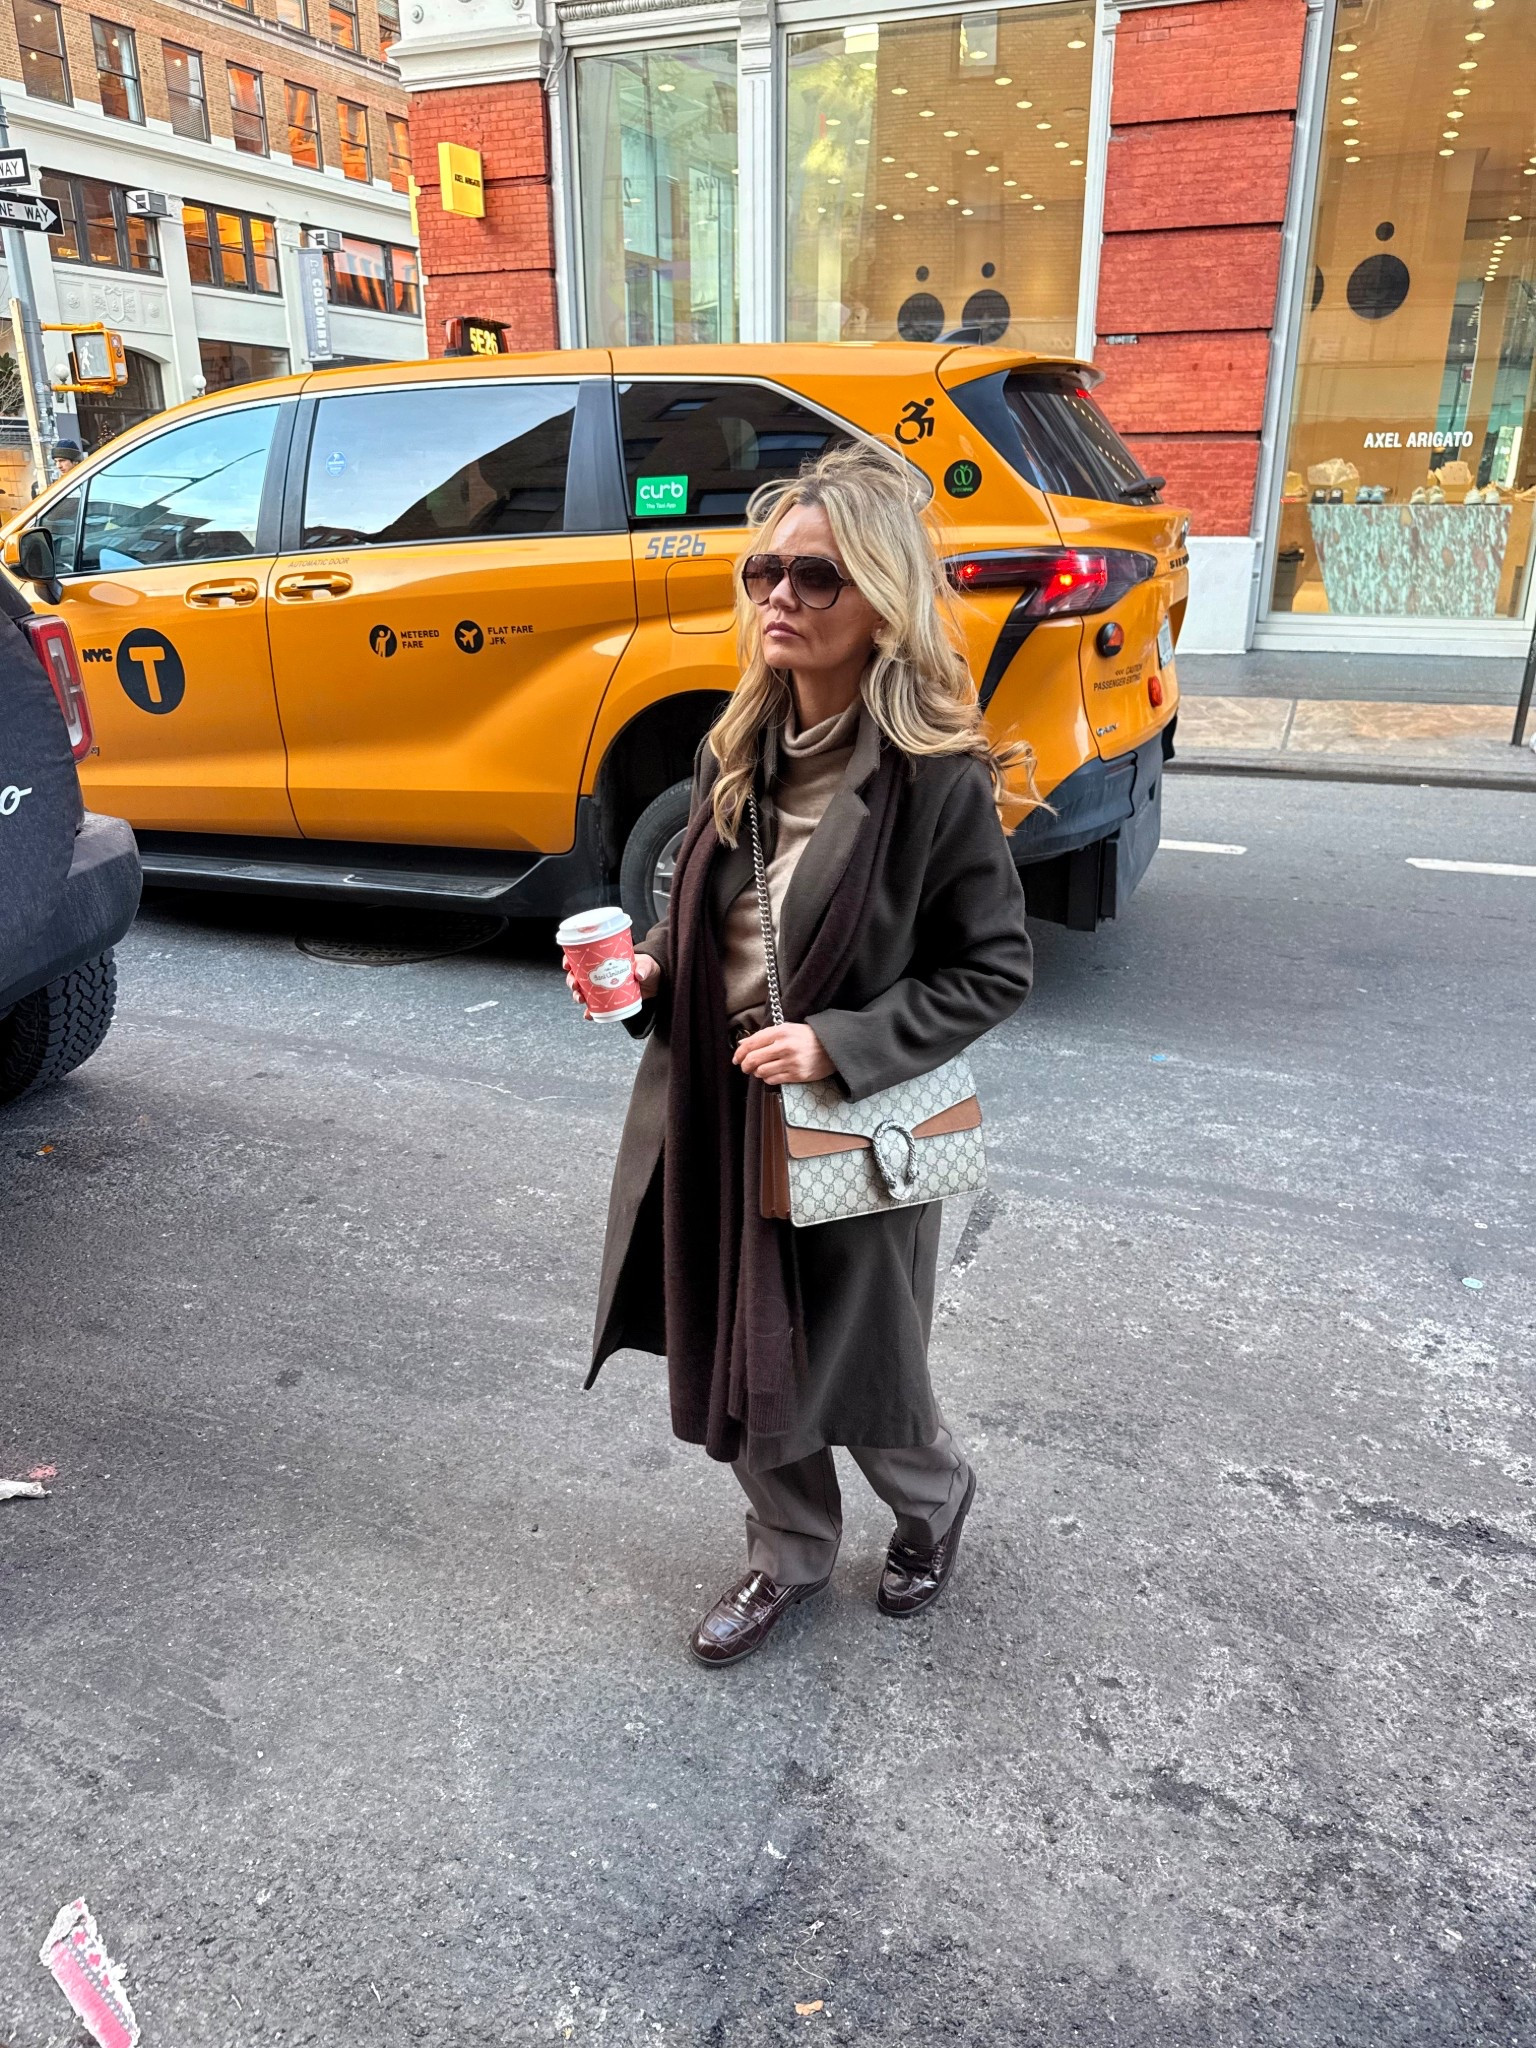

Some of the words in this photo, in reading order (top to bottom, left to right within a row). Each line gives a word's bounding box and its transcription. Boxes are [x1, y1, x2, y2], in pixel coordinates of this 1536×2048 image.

[0, 201, 15, 217] NE
[24, 205, 48, 223] WAY
[312, 278, 328, 350] COLOMBE
[469, 327, 499, 356] 5E26
[1363, 432, 1402, 448] AXEL
[1405, 431, 1474, 448] ARIGATO
[640, 481, 684, 500] curb
[288, 560, 328, 569] AUTOMATIC
[328, 558, 350, 566] DOOR
[400, 629, 440, 640] METERED
[487, 625, 509, 636] FLAT
[511, 625, 534, 635] FARE
[402, 640, 424, 649] FARE
[489, 636, 507, 646] JFK
[82, 648, 113, 663] NYC
[128, 646, 166, 703] T
[1093, 677, 1126, 692] PASSENGER
